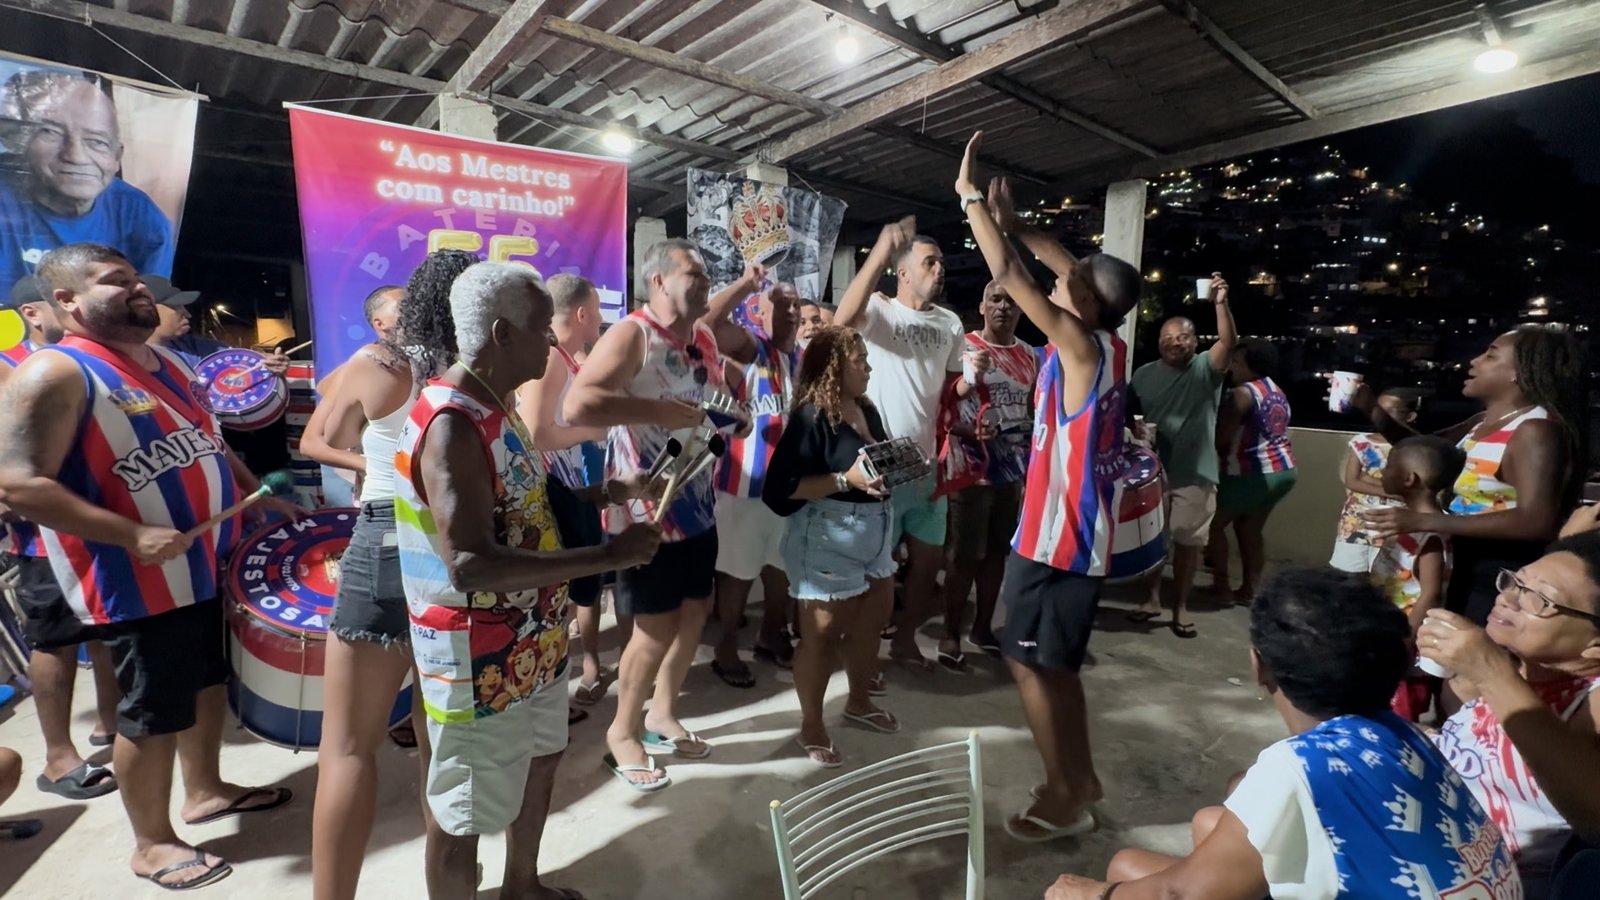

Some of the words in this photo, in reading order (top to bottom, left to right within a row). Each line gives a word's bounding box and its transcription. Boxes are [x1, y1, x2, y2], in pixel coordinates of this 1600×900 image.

[460, 152, 571, 189] Mestres
[376, 178, 444, 204] com
[452, 187, 575, 217] carinho!”
[111, 427, 225, 492] MAJES
[244, 518, 324, 628] MAJESTOSA
